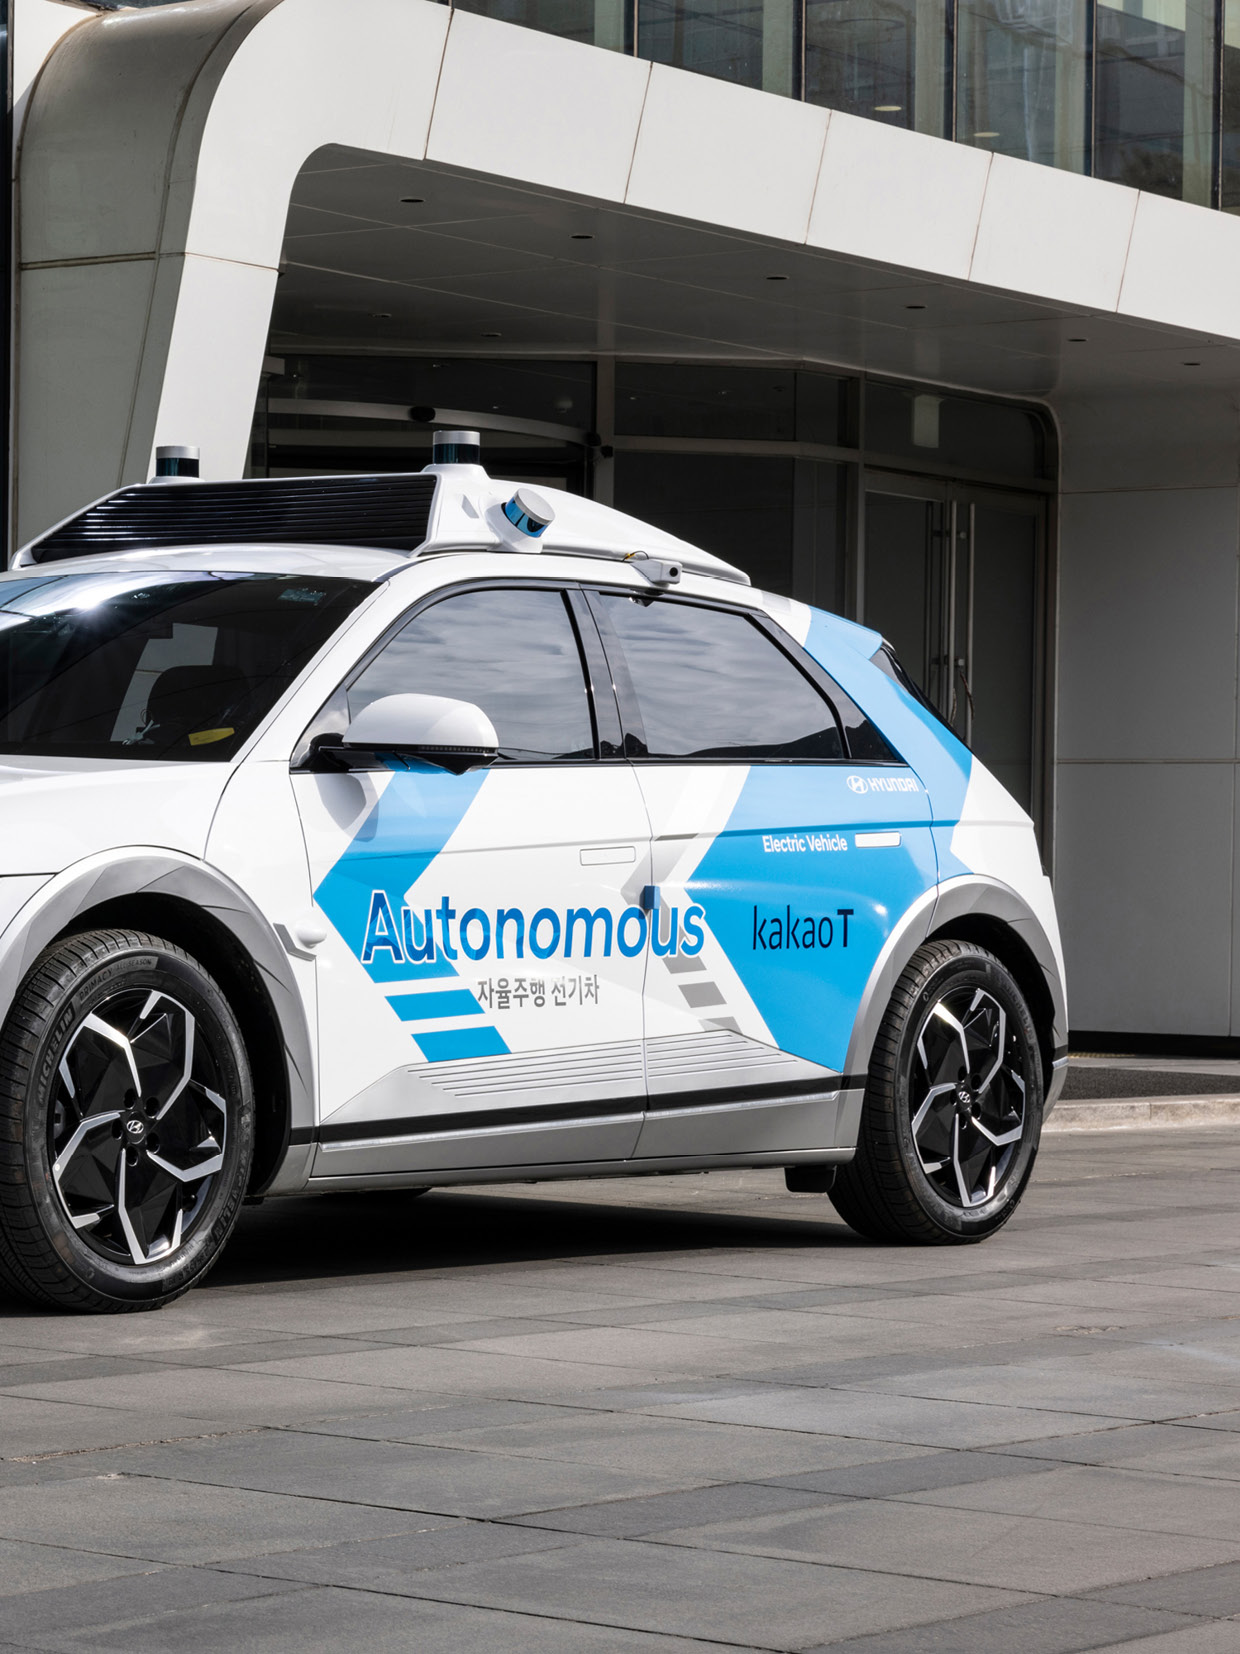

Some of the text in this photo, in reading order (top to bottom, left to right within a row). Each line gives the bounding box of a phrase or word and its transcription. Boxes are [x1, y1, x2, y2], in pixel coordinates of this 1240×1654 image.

[866, 777, 920, 792] HYUNDAI
[762, 833, 848, 853] Electric Vehicle
[362, 890, 705, 963] Autonomous
[477, 977, 546, 1009] 자율주행
[38, 1007, 73, 1104] MICHELIN
[79, 968, 113, 1001] PRIMACY
[128, 959, 152, 967] SEASON
